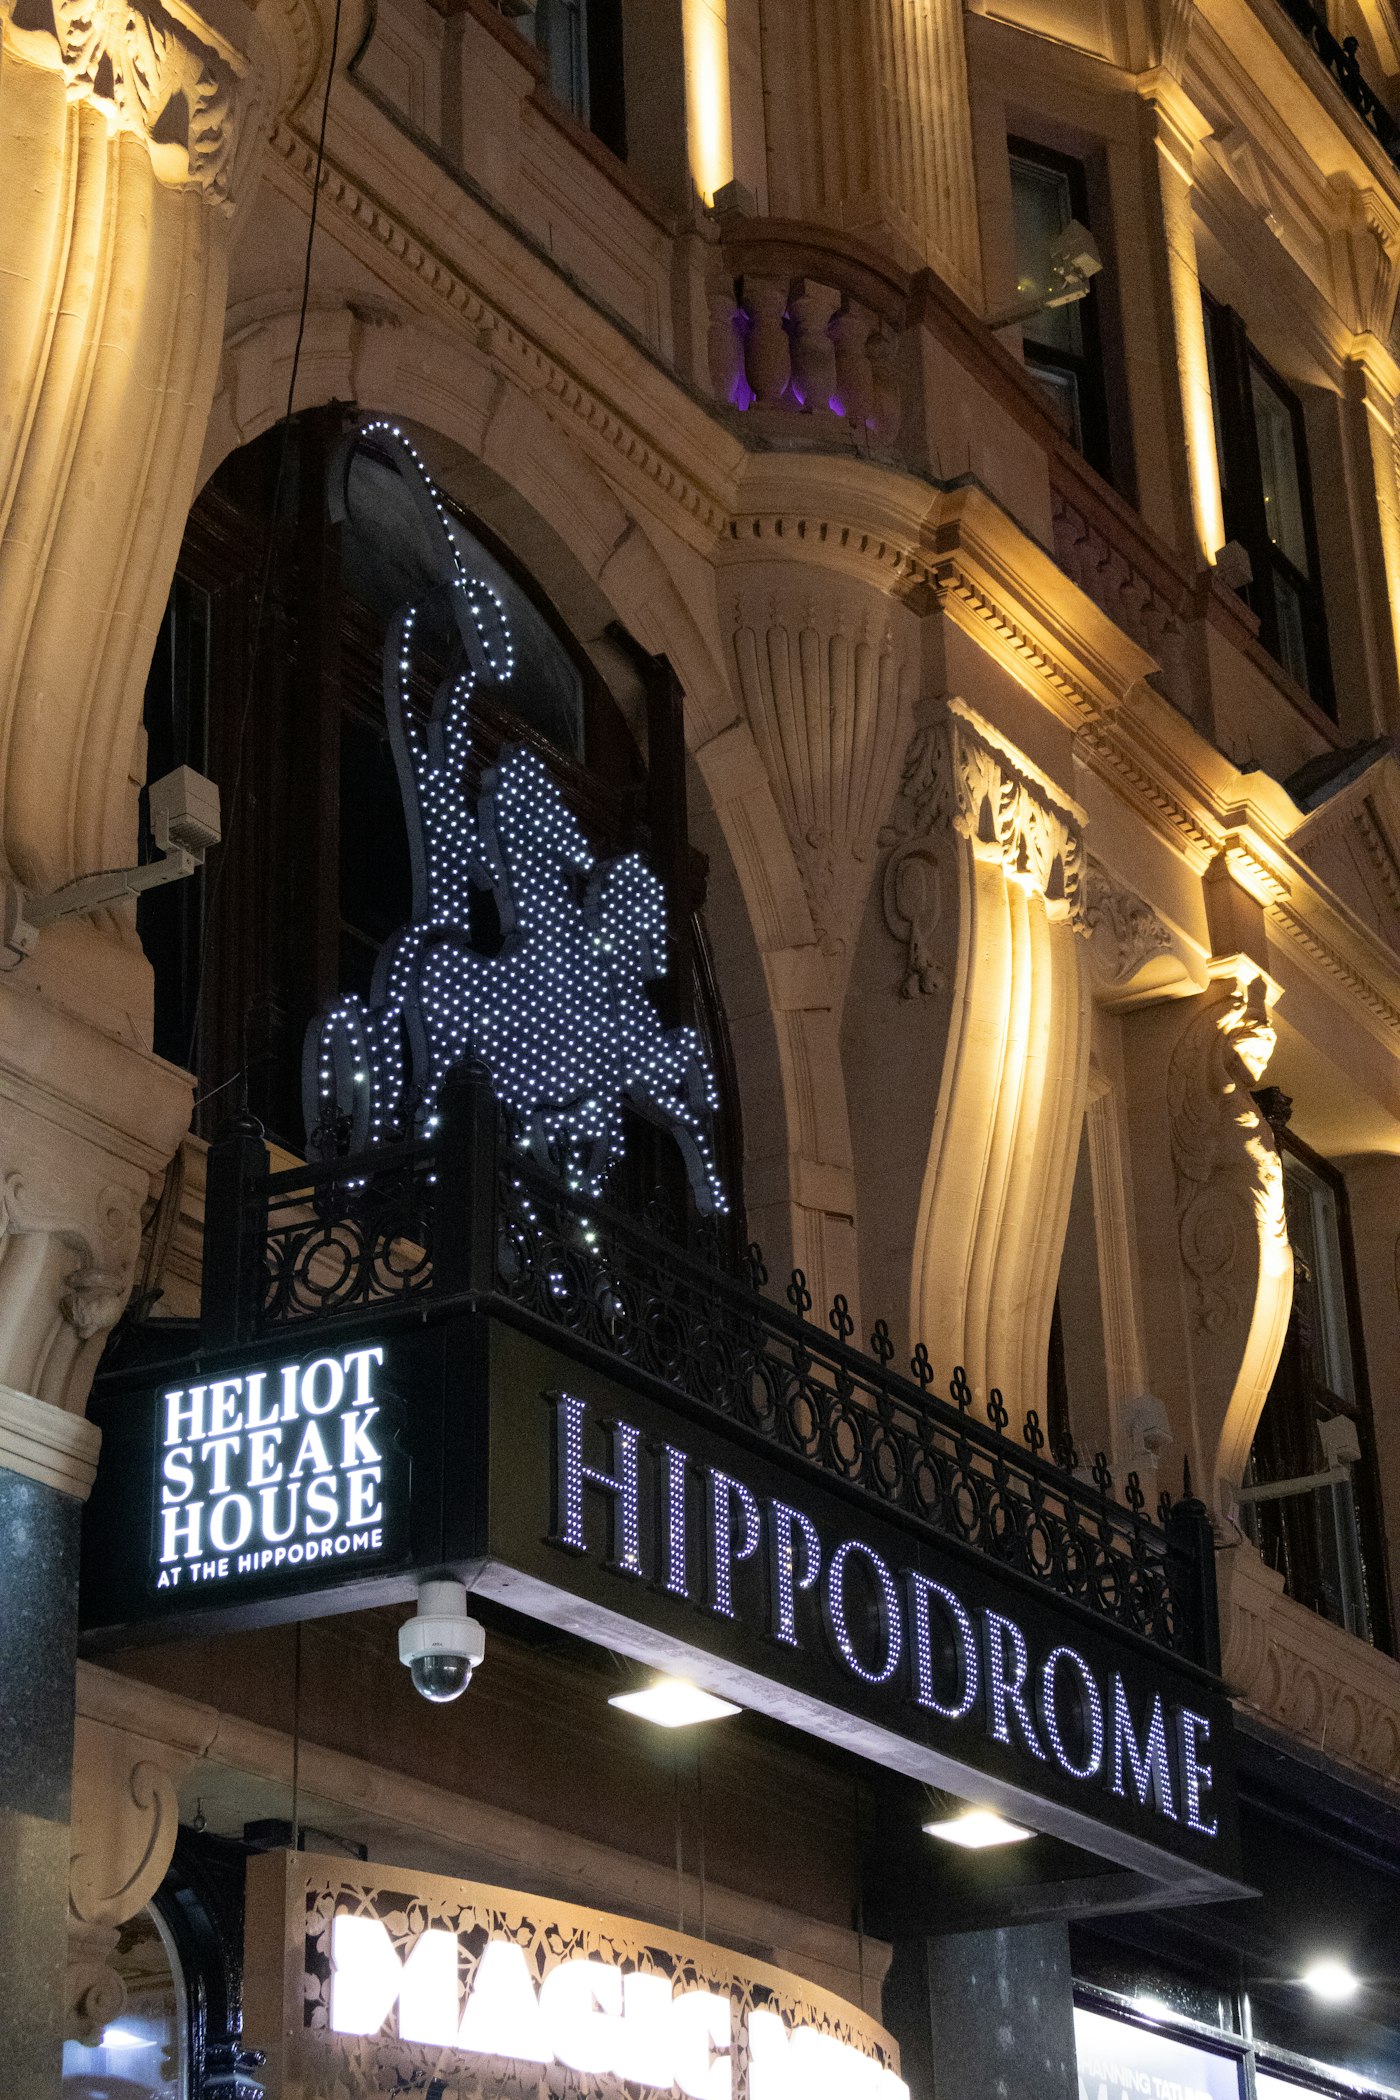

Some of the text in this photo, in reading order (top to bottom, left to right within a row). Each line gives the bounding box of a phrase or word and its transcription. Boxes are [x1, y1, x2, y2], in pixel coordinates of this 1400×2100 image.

[163, 1347, 383, 1446] HELIOT
[162, 1407, 382, 1504] STEAK
[157, 1529, 383, 1589] AT THE HIPPODROME
[160, 1466, 383, 1563] HOUSE
[556, 1391, 1218, 1837] HIPPODROME
[332, 1914, 732, 2100] MAGIC
